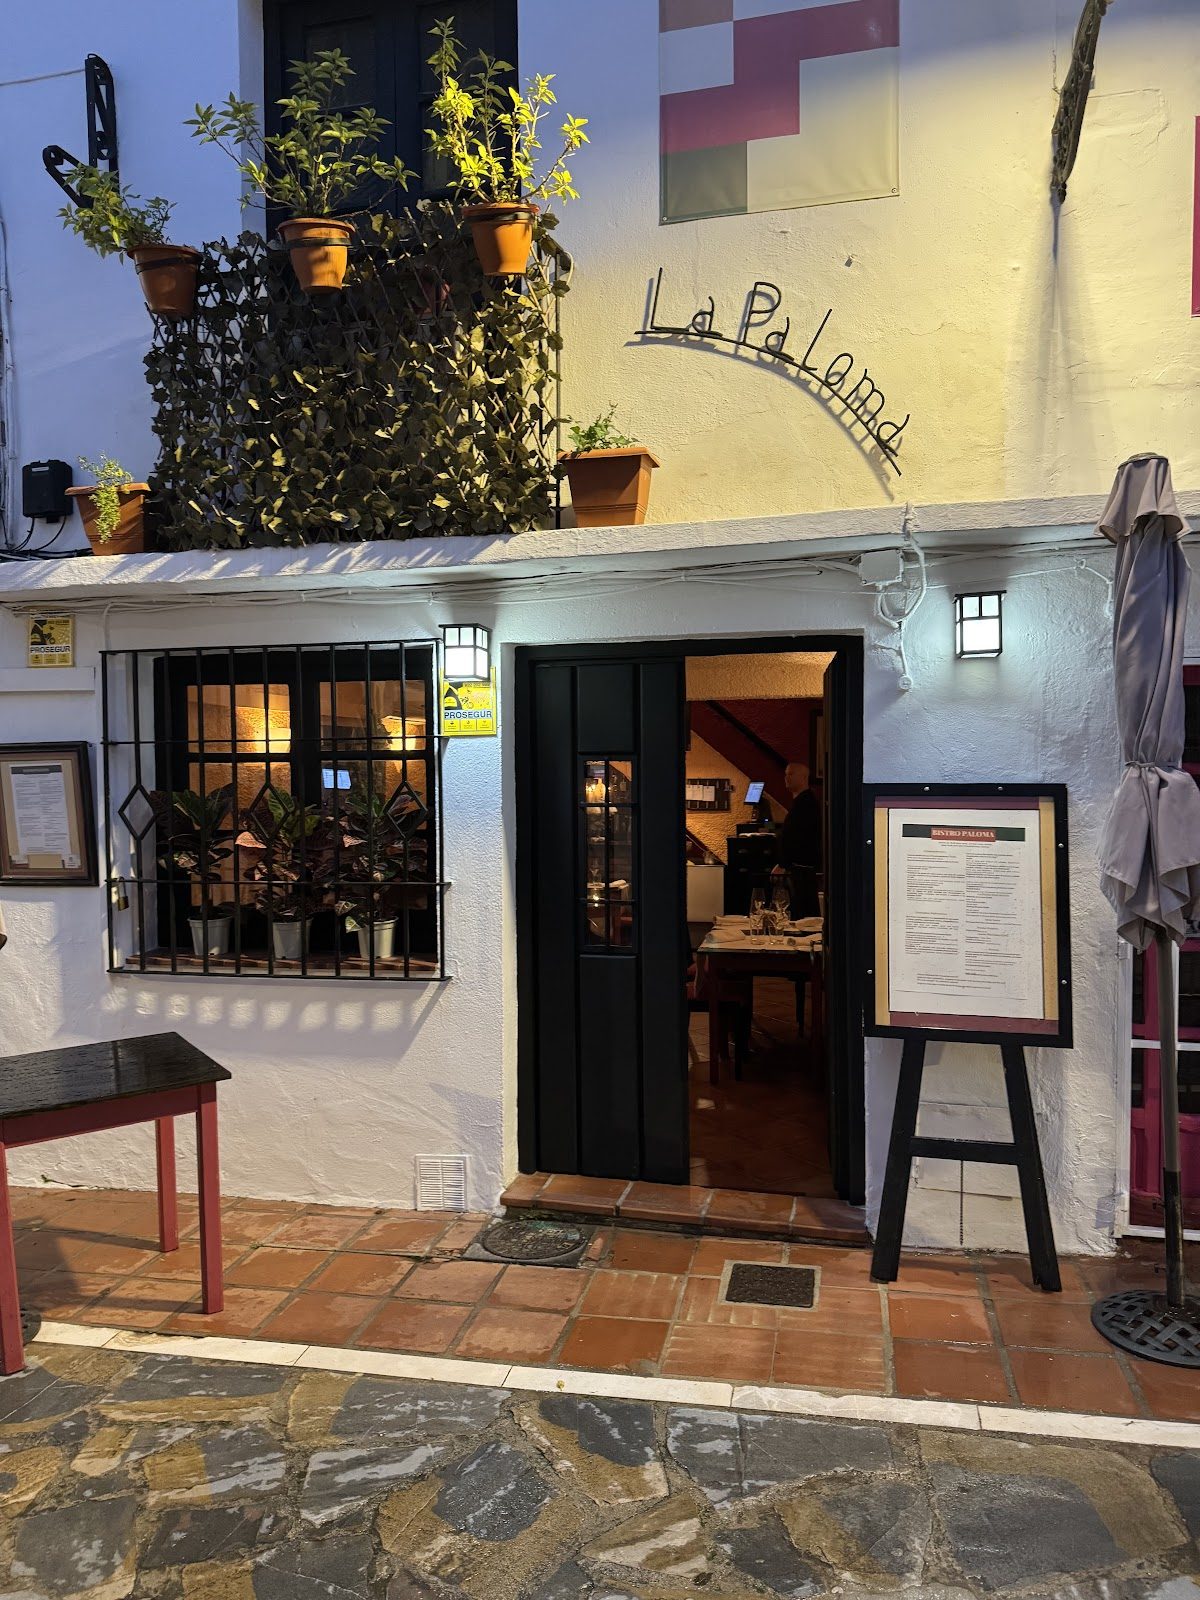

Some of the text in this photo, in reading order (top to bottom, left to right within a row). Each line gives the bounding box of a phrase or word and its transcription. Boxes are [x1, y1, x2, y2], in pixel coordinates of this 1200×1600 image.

[650, 267, 722, 338] La
[444, 711, 492, 719] PROSEGUR
[932, 829, 995, 838] BISTRO PALOMA
